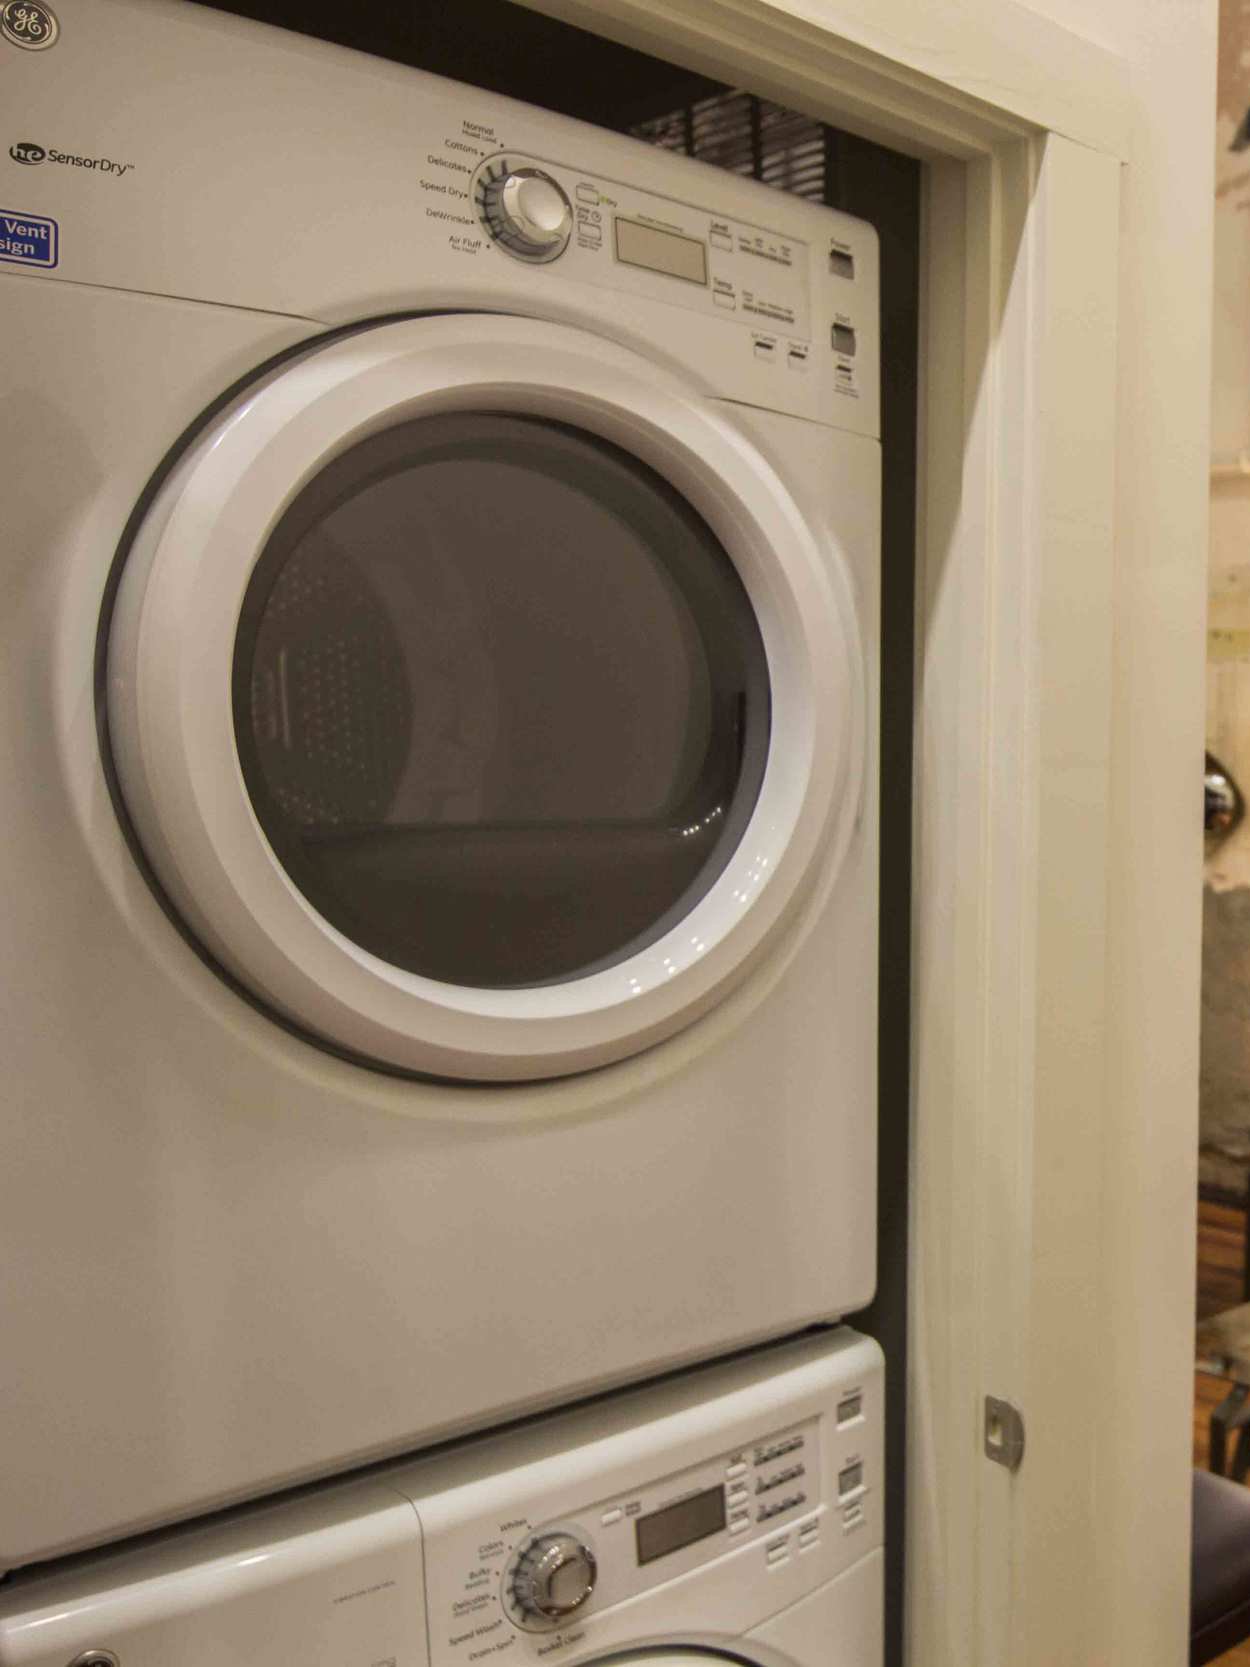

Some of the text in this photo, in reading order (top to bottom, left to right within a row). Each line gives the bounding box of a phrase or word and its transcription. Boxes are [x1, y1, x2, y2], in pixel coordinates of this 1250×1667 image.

[14, 8, 42, 35] GE
[463, 120, 495, 136] Normal
[444, 139, 478, 155] Cottons
[427, 154, 467, 173] Delicates
[419, 179, 463, 199] Speed Dry
[425, 207, 471, 225] DeWrinkle
[5, 219, 48, 241] Vent
[448, 235, 461, 245] Air
[462, 238, 482, 249] Fluff
